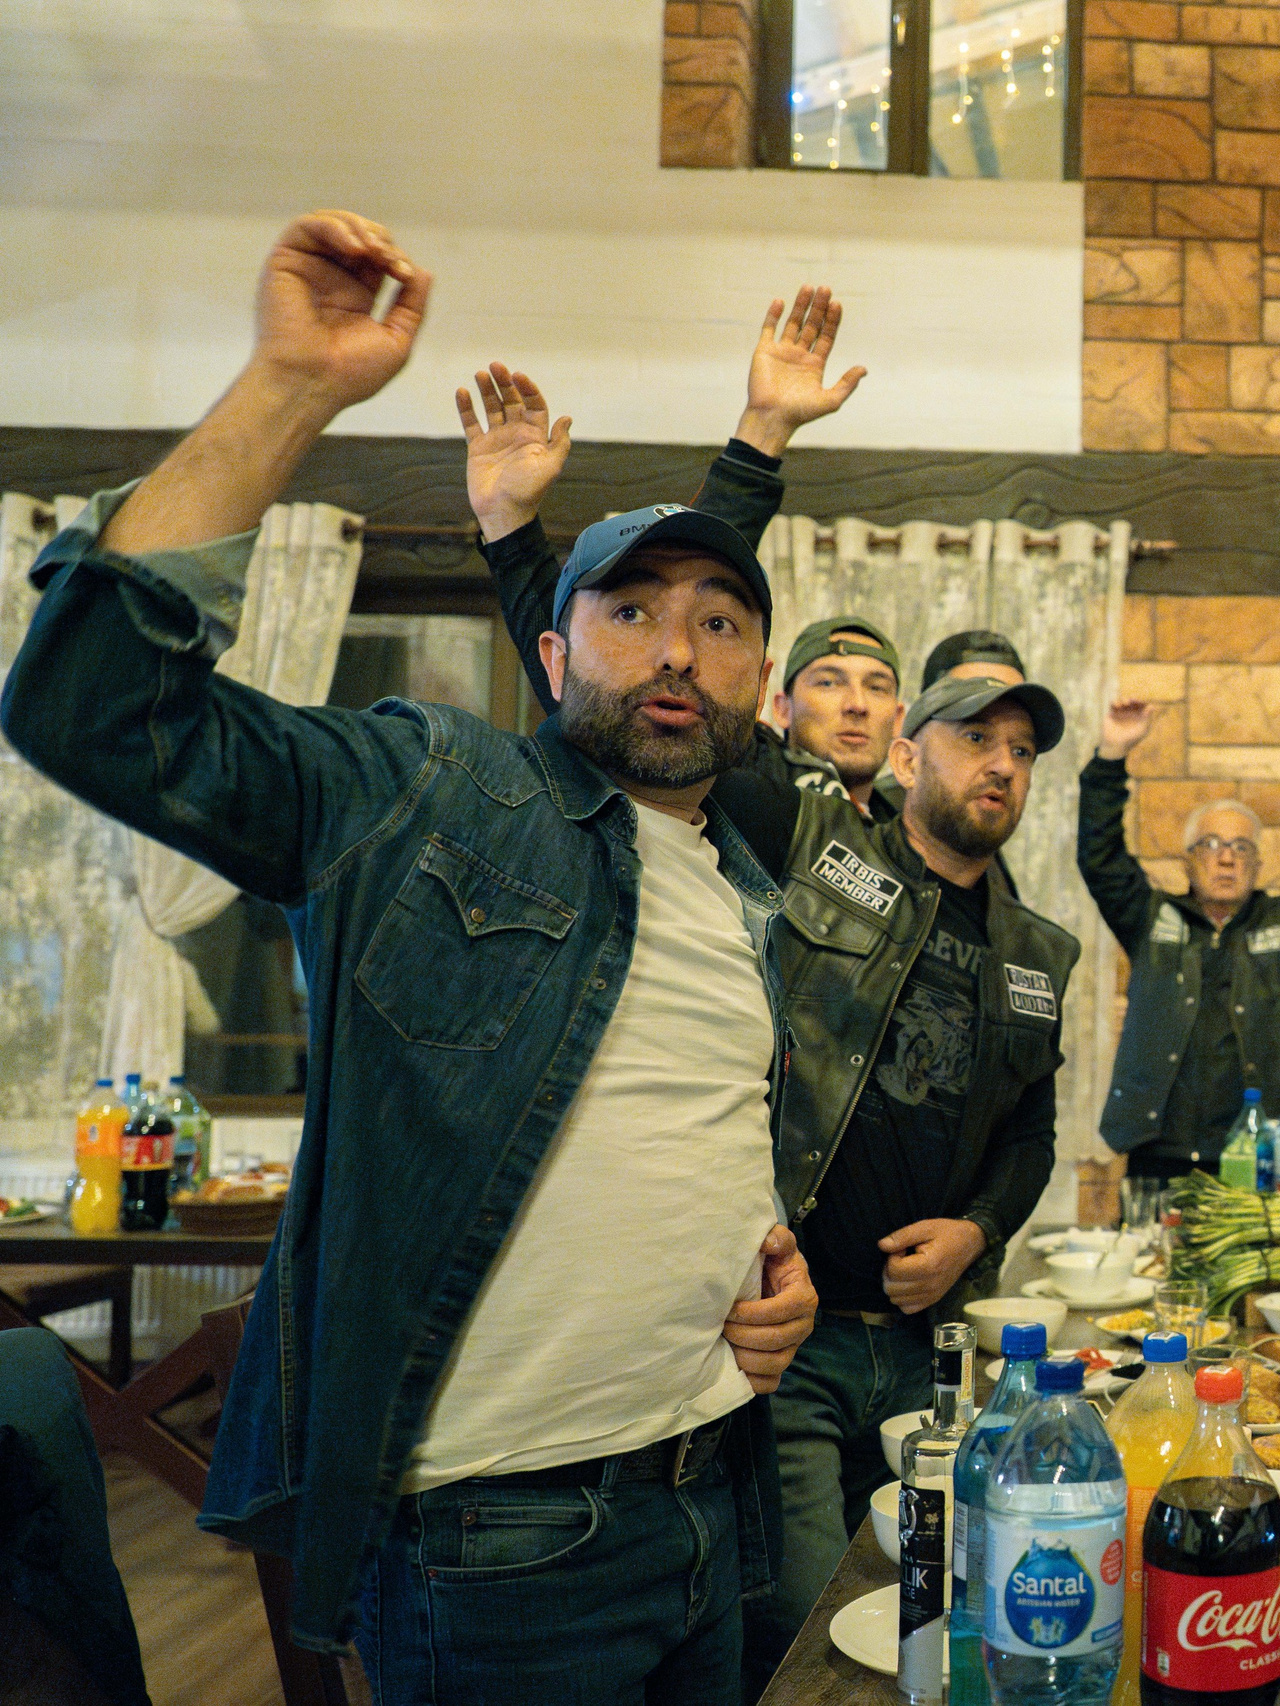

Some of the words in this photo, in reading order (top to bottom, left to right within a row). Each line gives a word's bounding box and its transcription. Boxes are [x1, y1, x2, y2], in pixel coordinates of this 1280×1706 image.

[619, 523, 651, 537] BM
[818, 861, 885, 911] MEMBER
[840, 852, 886, 890] IRBIS
[1012, 1571, 1087, 1597] Santal
